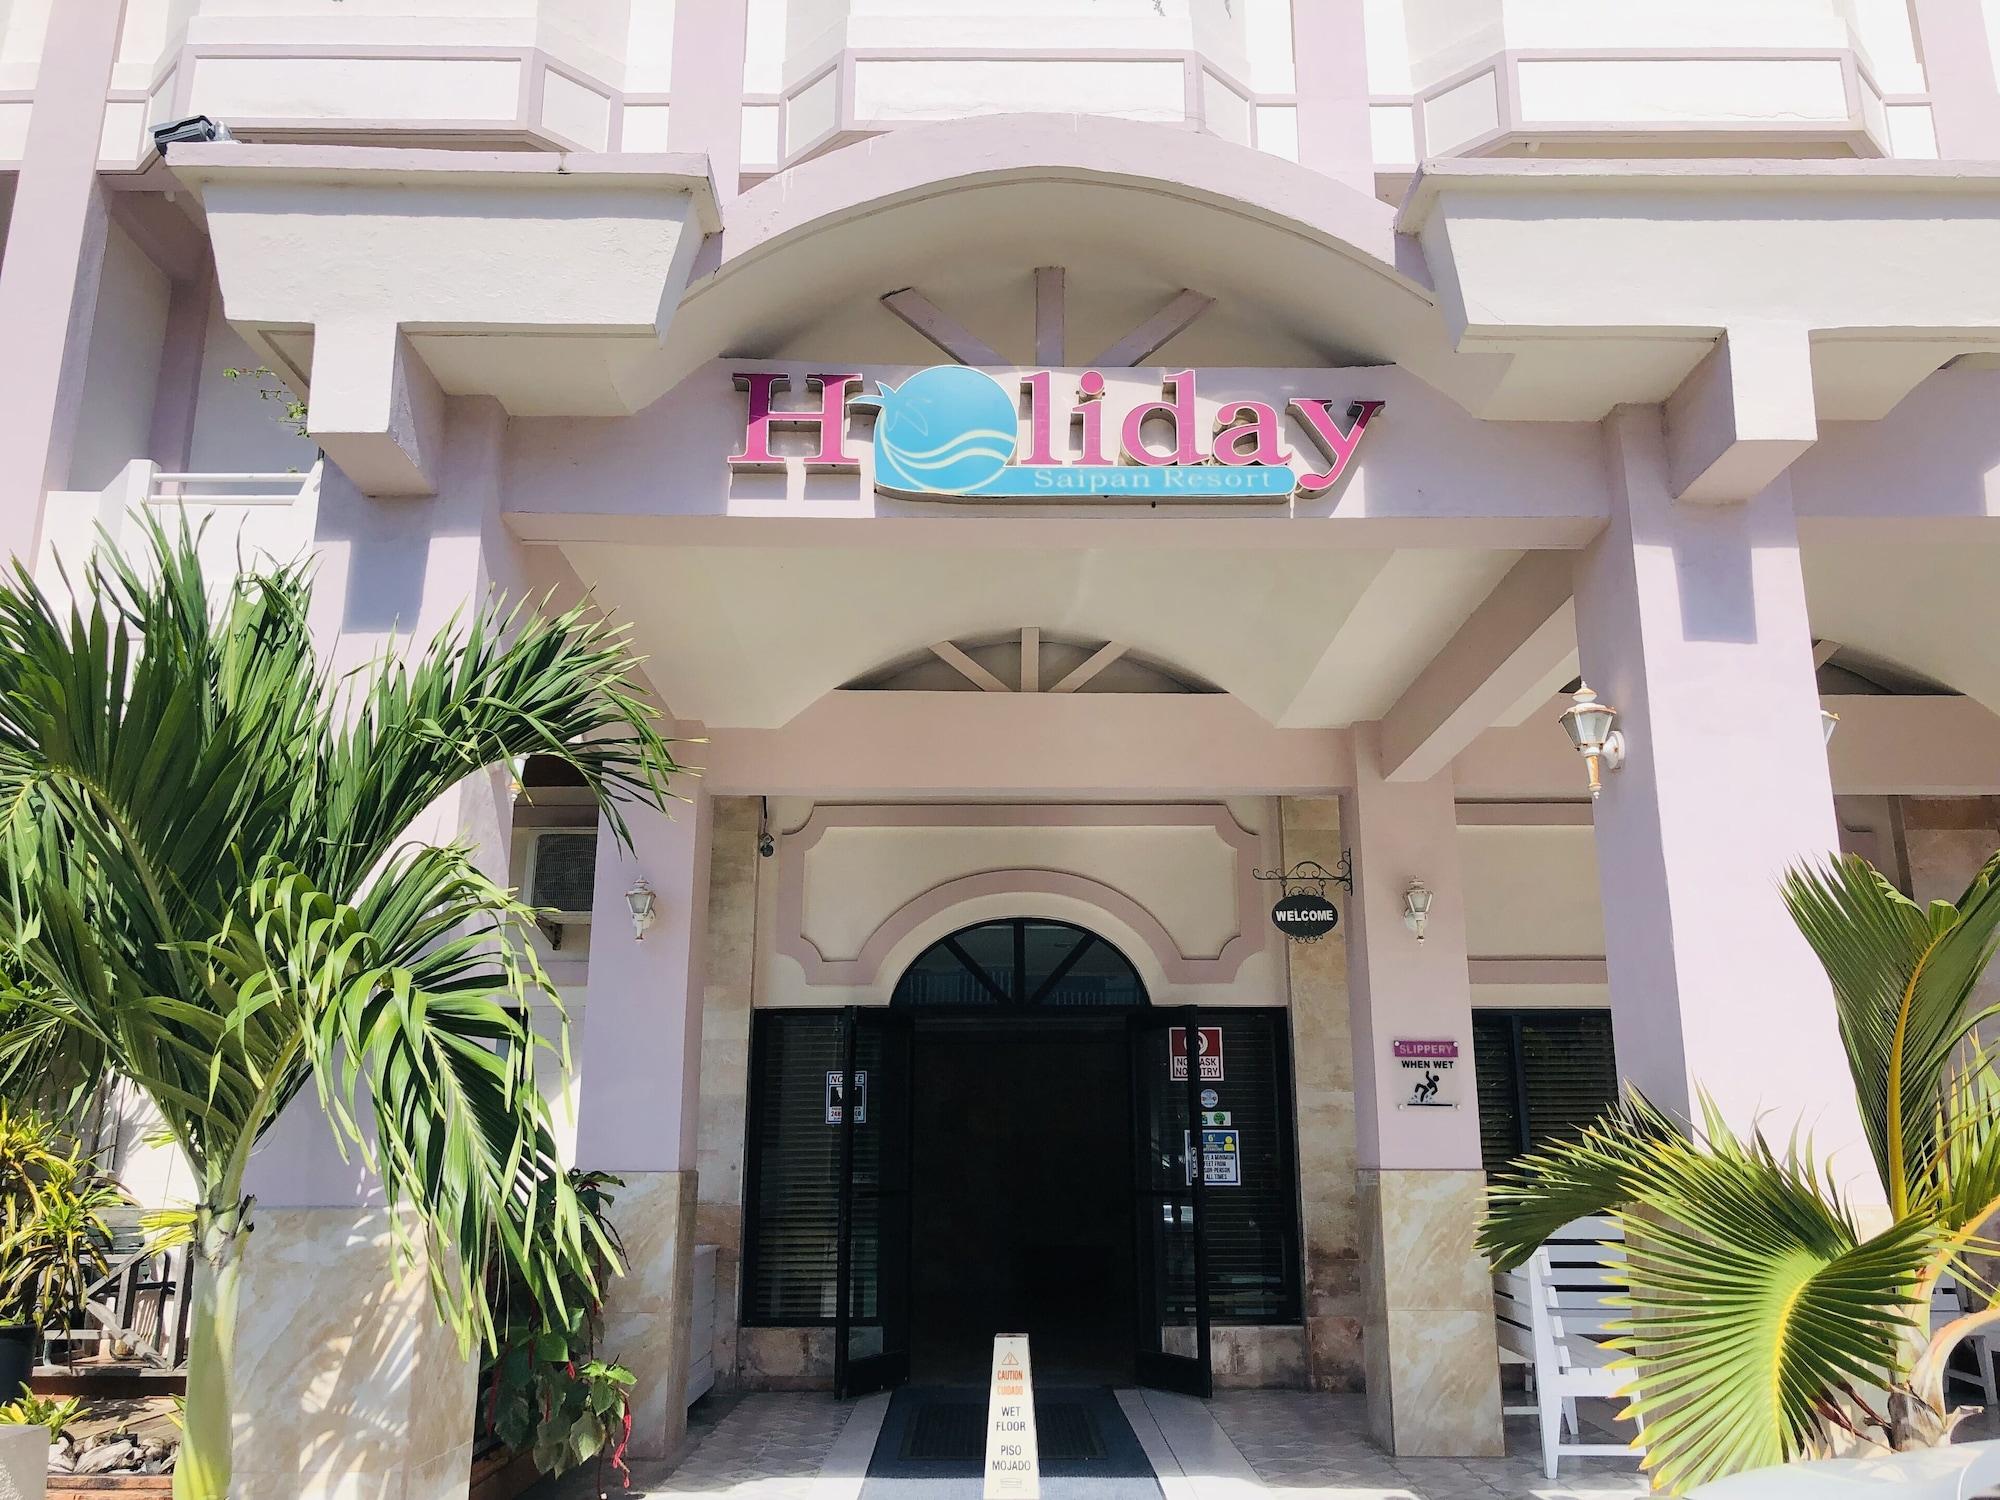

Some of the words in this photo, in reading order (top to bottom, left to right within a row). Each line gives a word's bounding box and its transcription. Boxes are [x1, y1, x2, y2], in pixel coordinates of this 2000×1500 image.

[728, 369, 1385, 493] Holiday
[1033, 469, 1156, 493] Saipan
[1171, 468, 1271, 489] Resort
[1276, 910, 1334, 922] WELCOME
[1400, 1044, 1453, 1055] SLIPPERY
[1199, 1057, 1217, 1066] ASK
[1401, 1060, 1430, 1069] WHEN
[1433, 1060, 1454, 1069] WET
[1199, 1067, 1218, 1076] TRY
[997, 1370, 1023, 1381] CAUTION
[1001, 1406, 1021, 1417] WET
[996, 1421, 1026, 1432] FLOOR
[1000, 1445, 1022, 1456] PISO
[992, 1460, 1031, 1471] MOJADO
